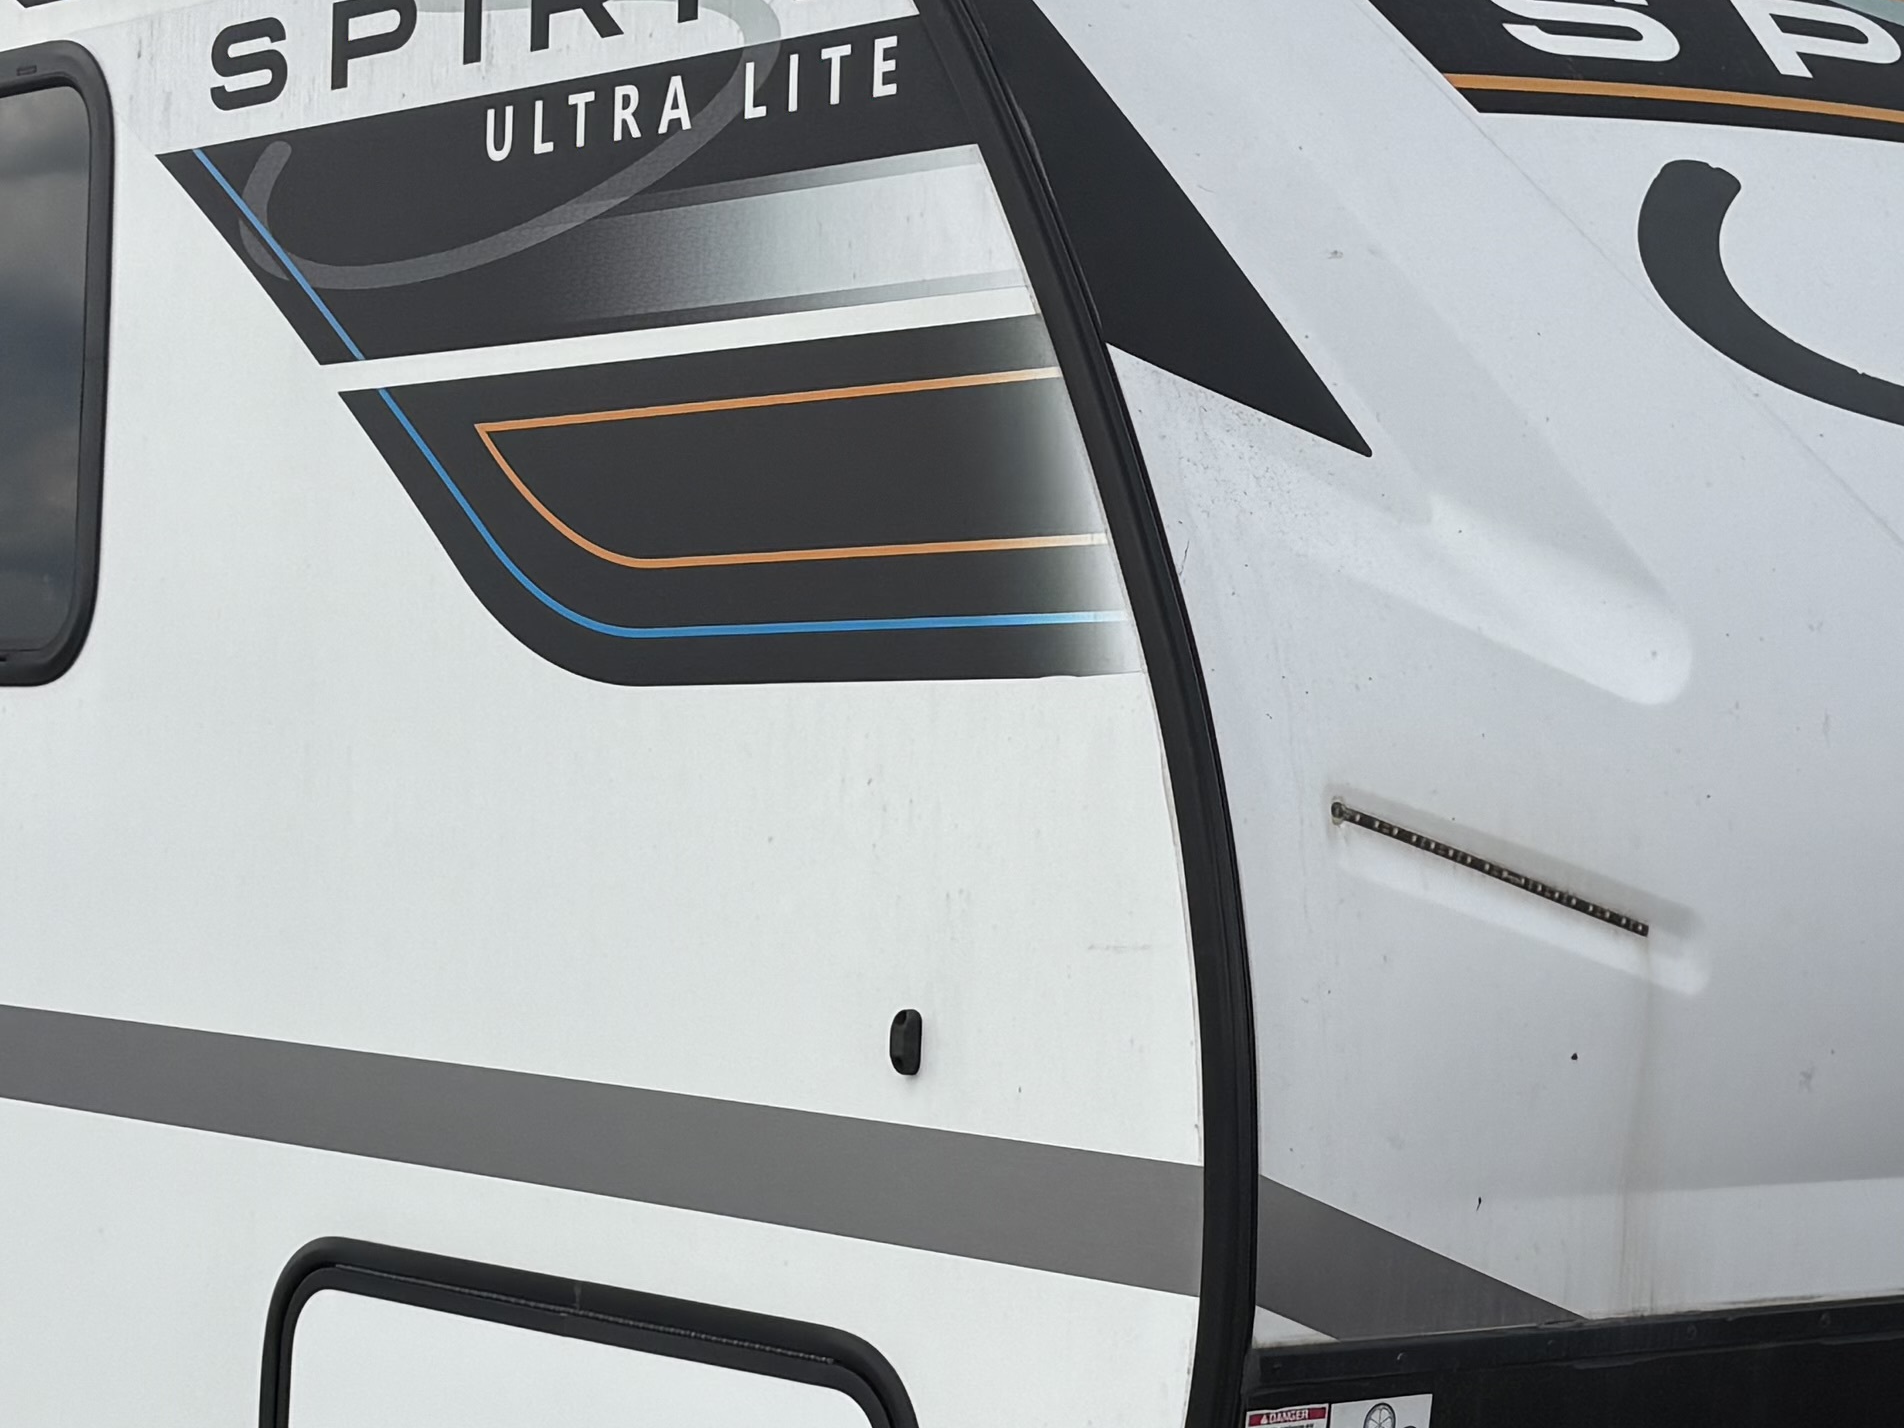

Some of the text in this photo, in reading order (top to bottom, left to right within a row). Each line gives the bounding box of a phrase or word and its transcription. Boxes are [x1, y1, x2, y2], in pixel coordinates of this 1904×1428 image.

[484, 35, 900, 162] ULTRA LITE
[1268, 1409, 1309, 1424] DANGER
